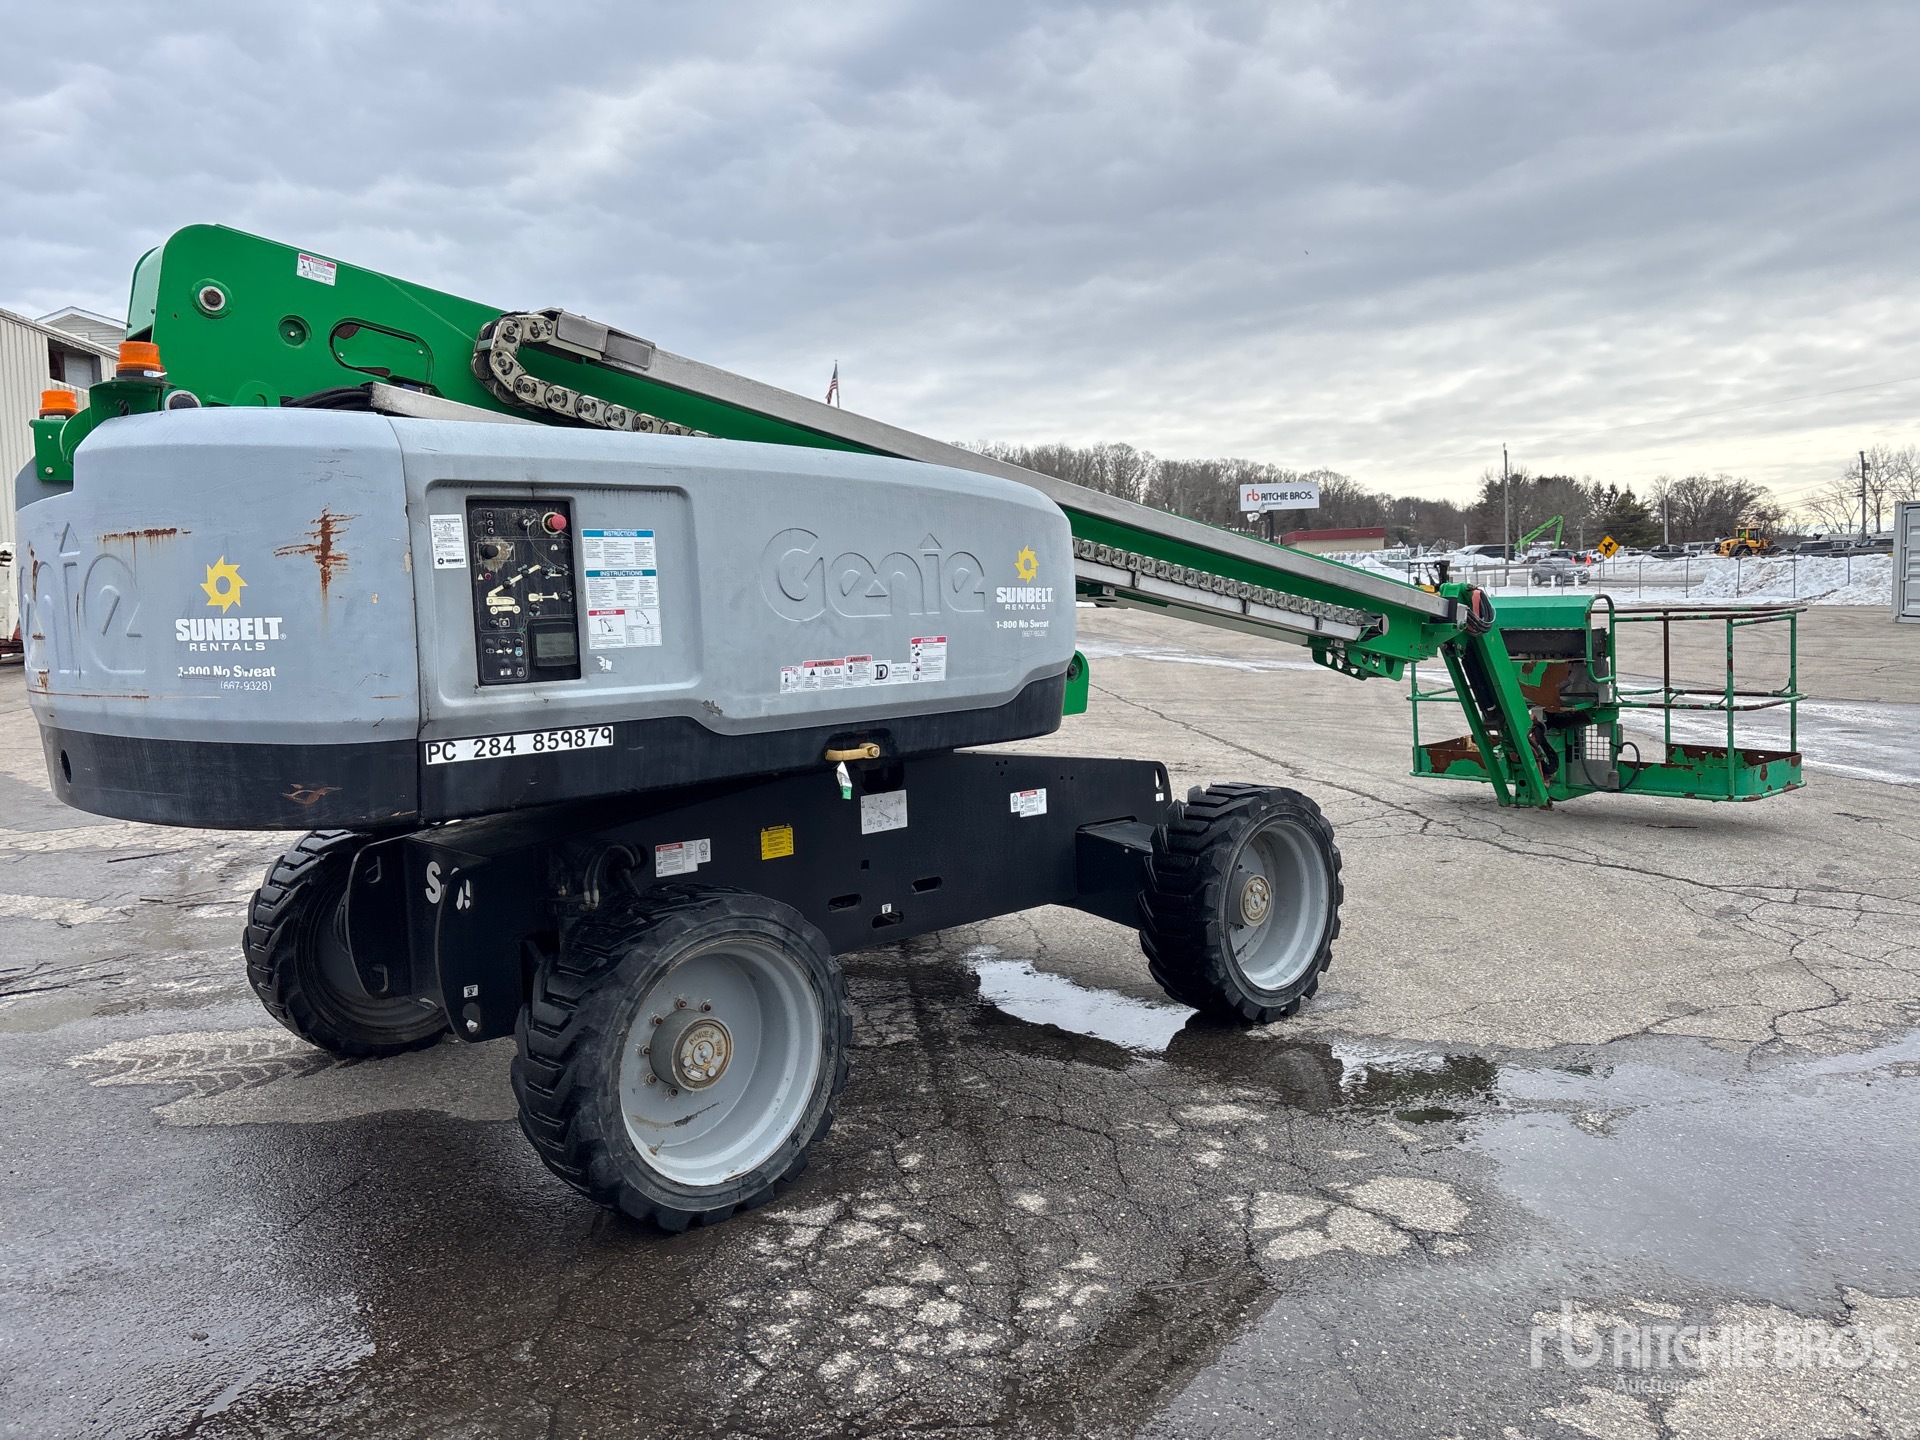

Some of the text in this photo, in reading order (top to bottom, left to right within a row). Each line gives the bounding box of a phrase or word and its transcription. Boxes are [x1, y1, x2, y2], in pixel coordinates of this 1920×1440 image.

[1246, 489, 1260, 501] rb
[1261, 492, 1289, 501] RITCHIE
[760, 528, 985, 622] Genie
[996, 587, 1053, 603] SUNBELT
[175, 617, 282, 641] SUNBELT
[996, 620, 1049, 629] 1-800 No Sweat
[190, 642, 266, 651] RENTALS
[178, 665, 276, 678] 1-800 No Sweat
[427, 727, 612, 763] PC 284 859879
